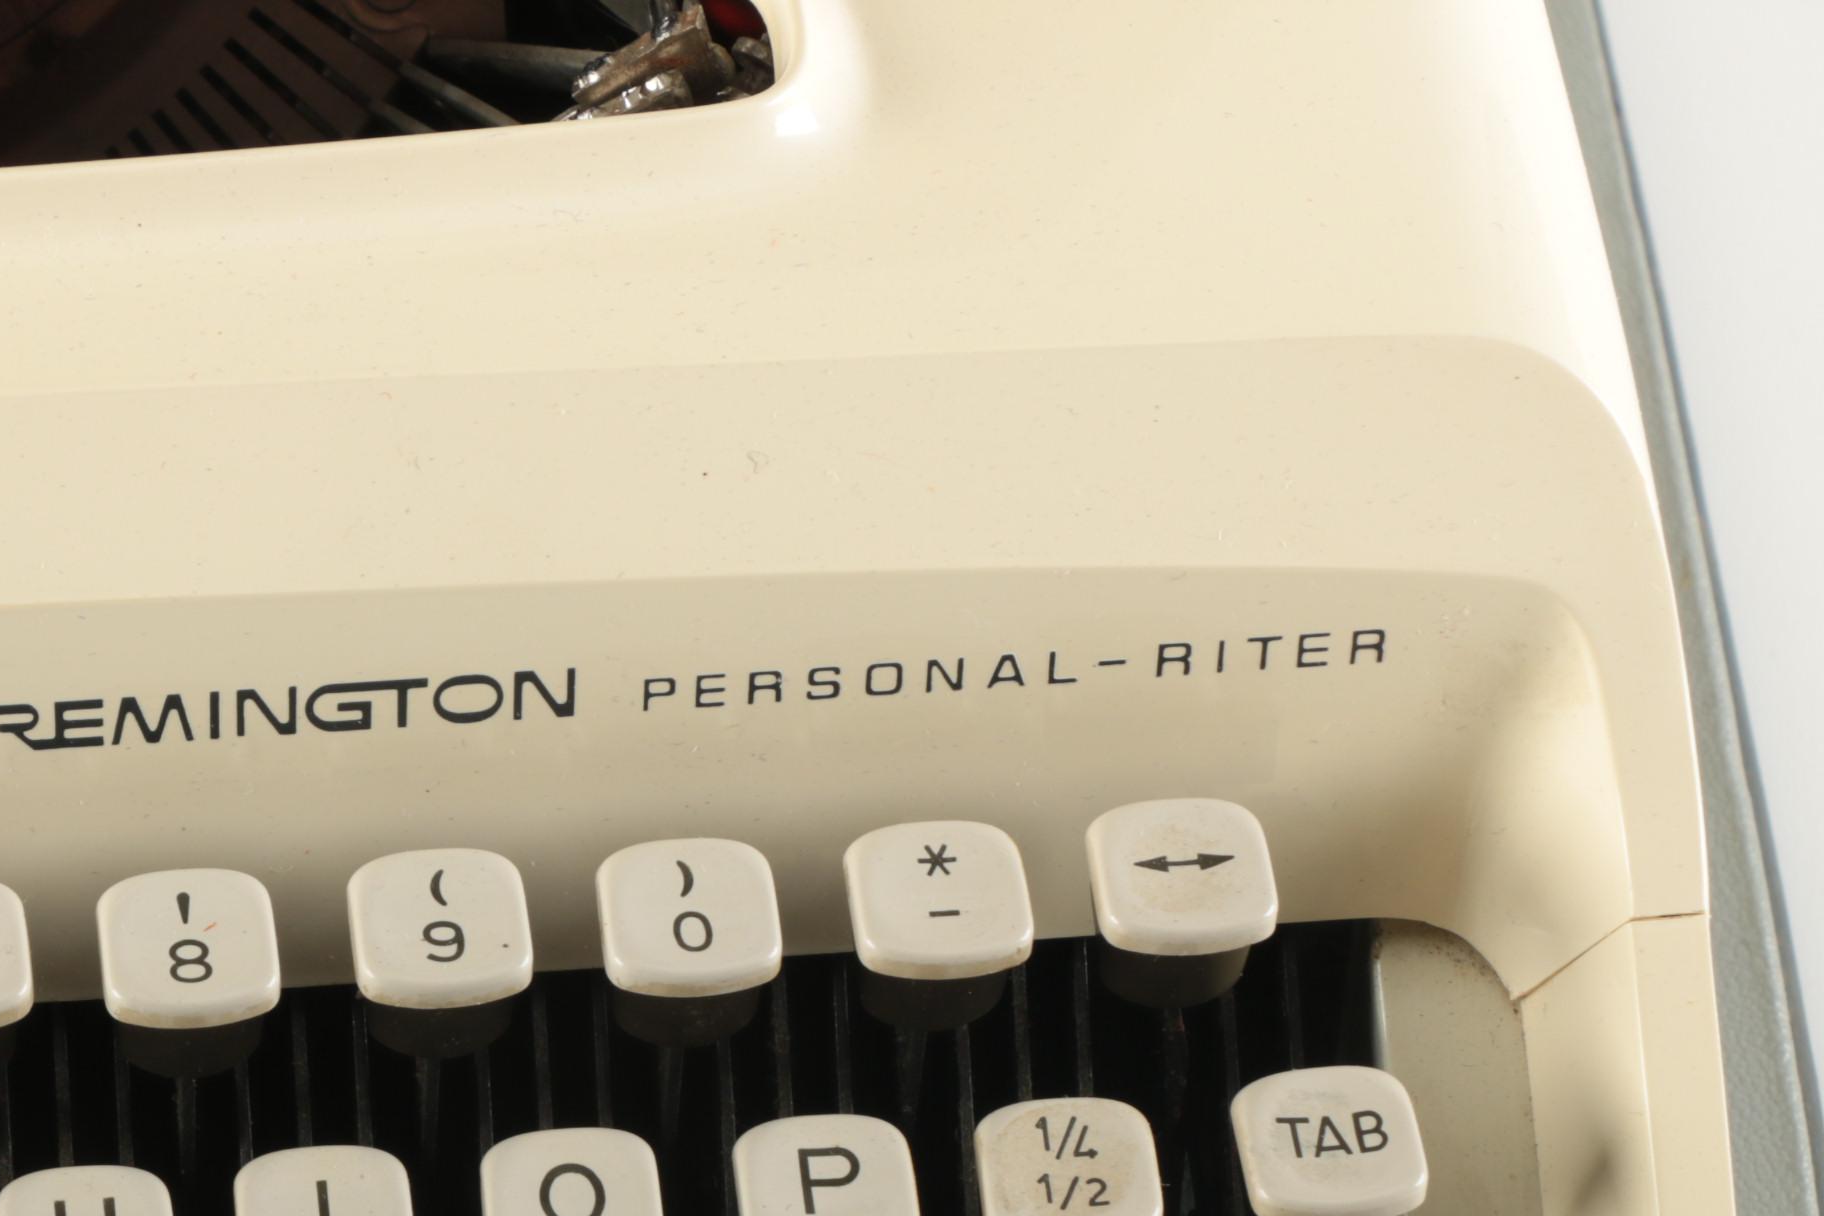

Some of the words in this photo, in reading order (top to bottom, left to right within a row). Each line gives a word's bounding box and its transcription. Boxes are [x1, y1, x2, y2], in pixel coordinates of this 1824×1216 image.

[643, 629, 1386, 712] PERSONAL-RITER
[430, 870, 447, 907] (
[168, 939, 213, 983] 8
[422, 920, 465, 963] 9
[1035, 1116, 1098, 1160] 1/4
[1275, 1110, 1389, 1158] TAB
[797, 1146, 861, 1215] P
[1037, 1173, 1110, 1211] 1/2
